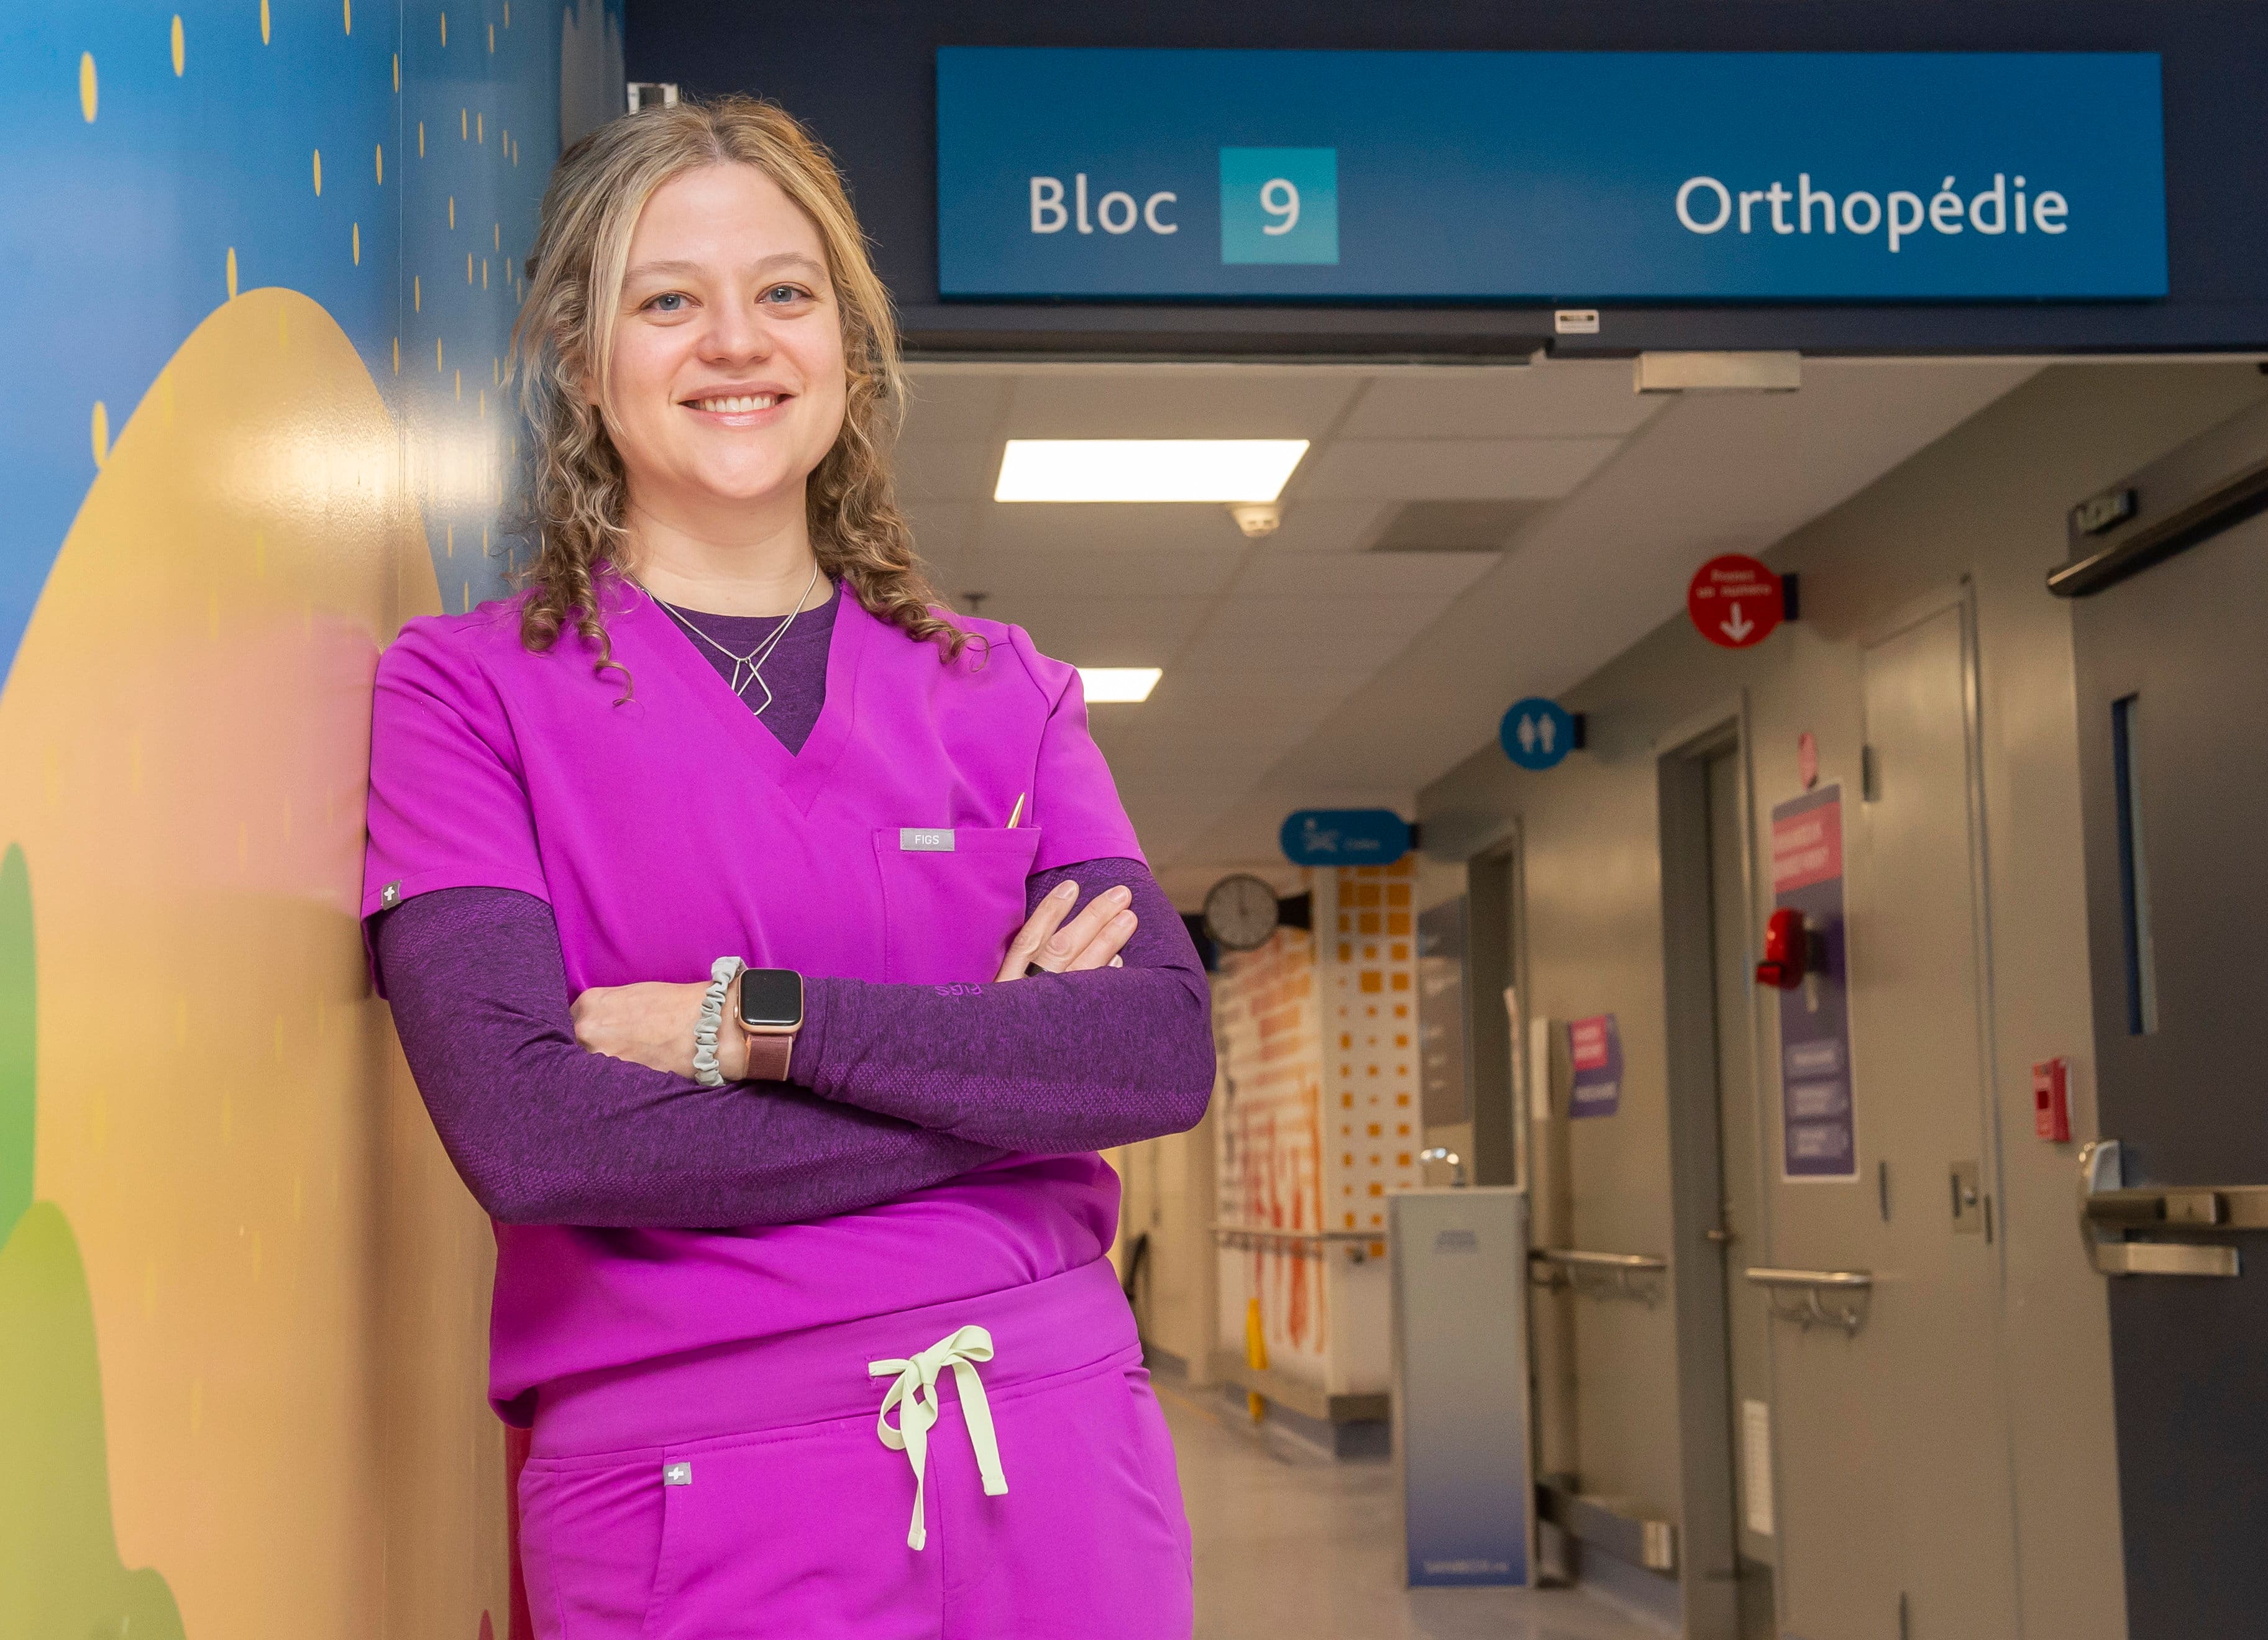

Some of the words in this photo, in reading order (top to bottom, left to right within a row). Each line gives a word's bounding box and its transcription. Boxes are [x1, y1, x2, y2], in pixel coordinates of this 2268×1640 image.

[1030, 172, 1178, 235] Bloc
[1259, 178, 1301, 236] 9
[1675, 172, 2069, 253] Orthopédie
[915, 834, 940, 845] FIGS
